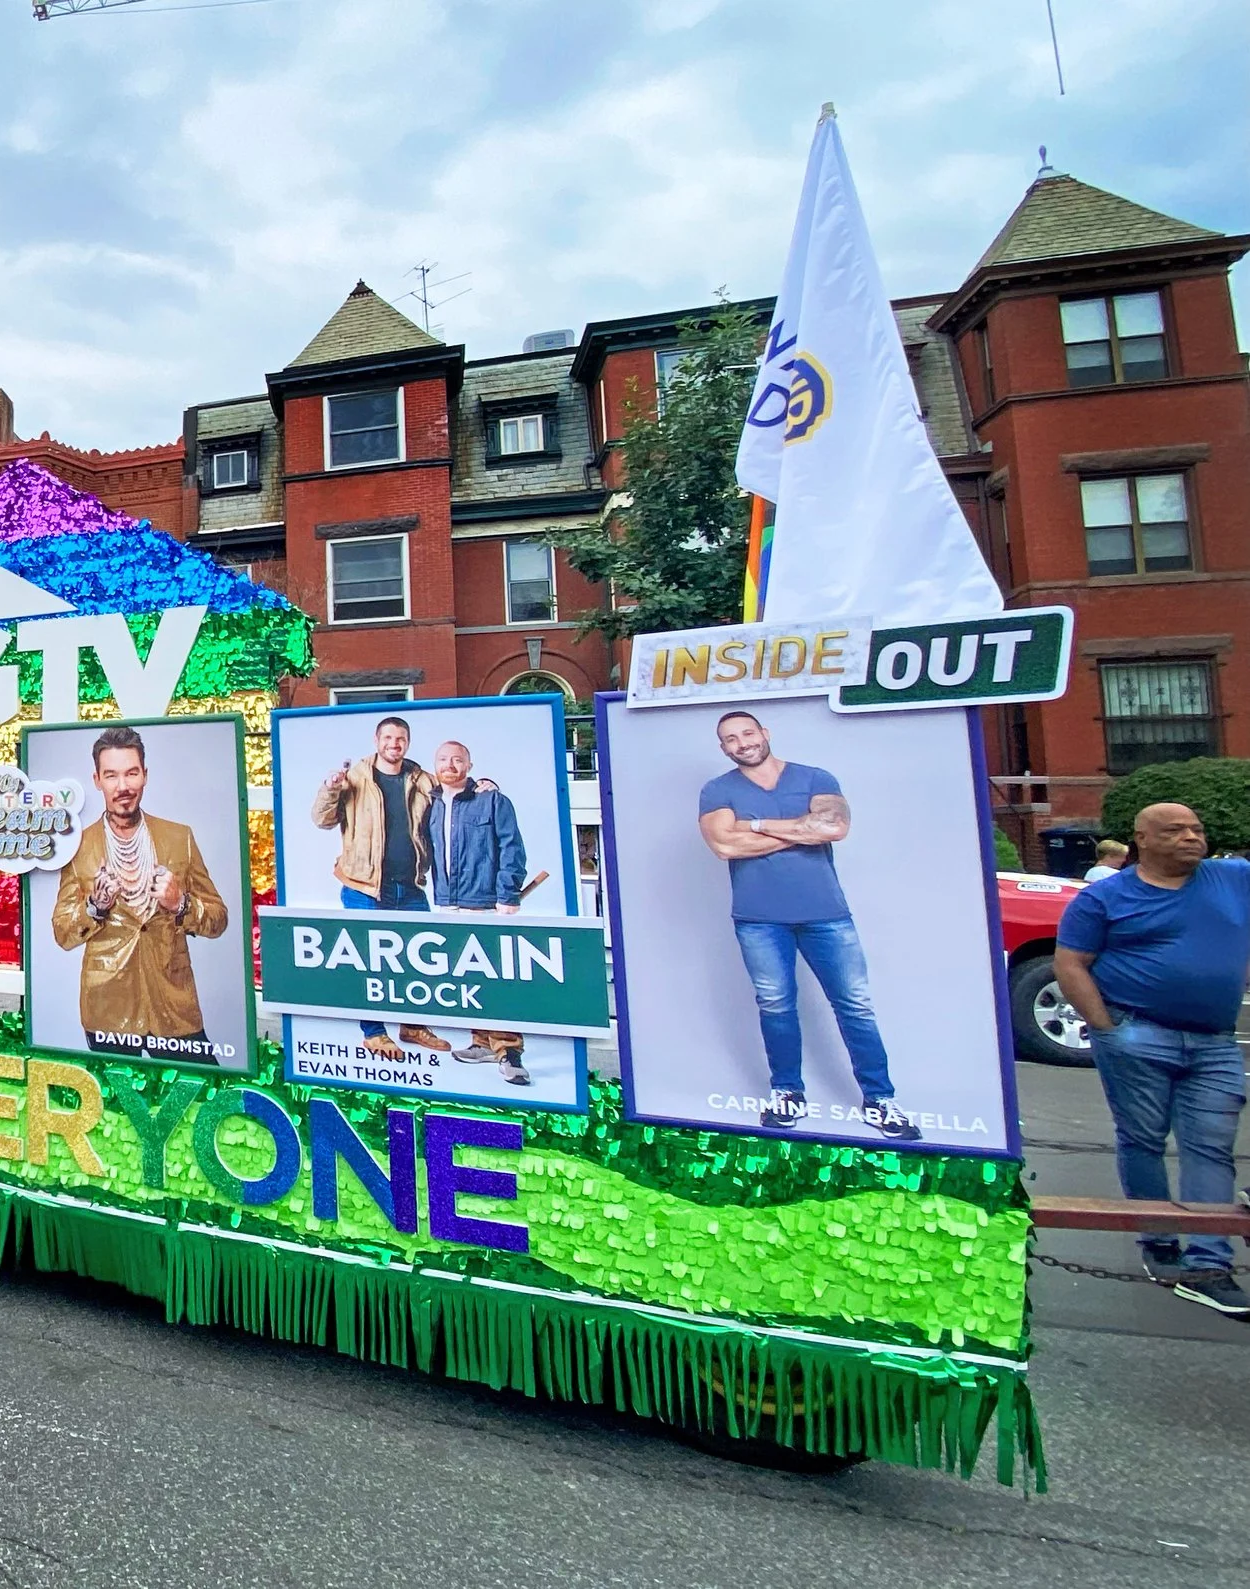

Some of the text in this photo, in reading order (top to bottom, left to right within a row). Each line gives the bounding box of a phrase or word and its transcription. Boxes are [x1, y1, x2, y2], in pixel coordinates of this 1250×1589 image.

[652, 629, 1033, 691] INSIDE OUT
[292, 925, 565, 983] BARGAIN
[366, 977, 484, 1011] BLOCK
[95, 1030, 236, 1058] DAVID BROMSTAD
[297, 1040, 441, 1067] KEITH BYNUM &
[297, 1060, 434, 1087] EVAN THOMAS
[707, 1092, 989, 1134] CARMINE SABATELLA
